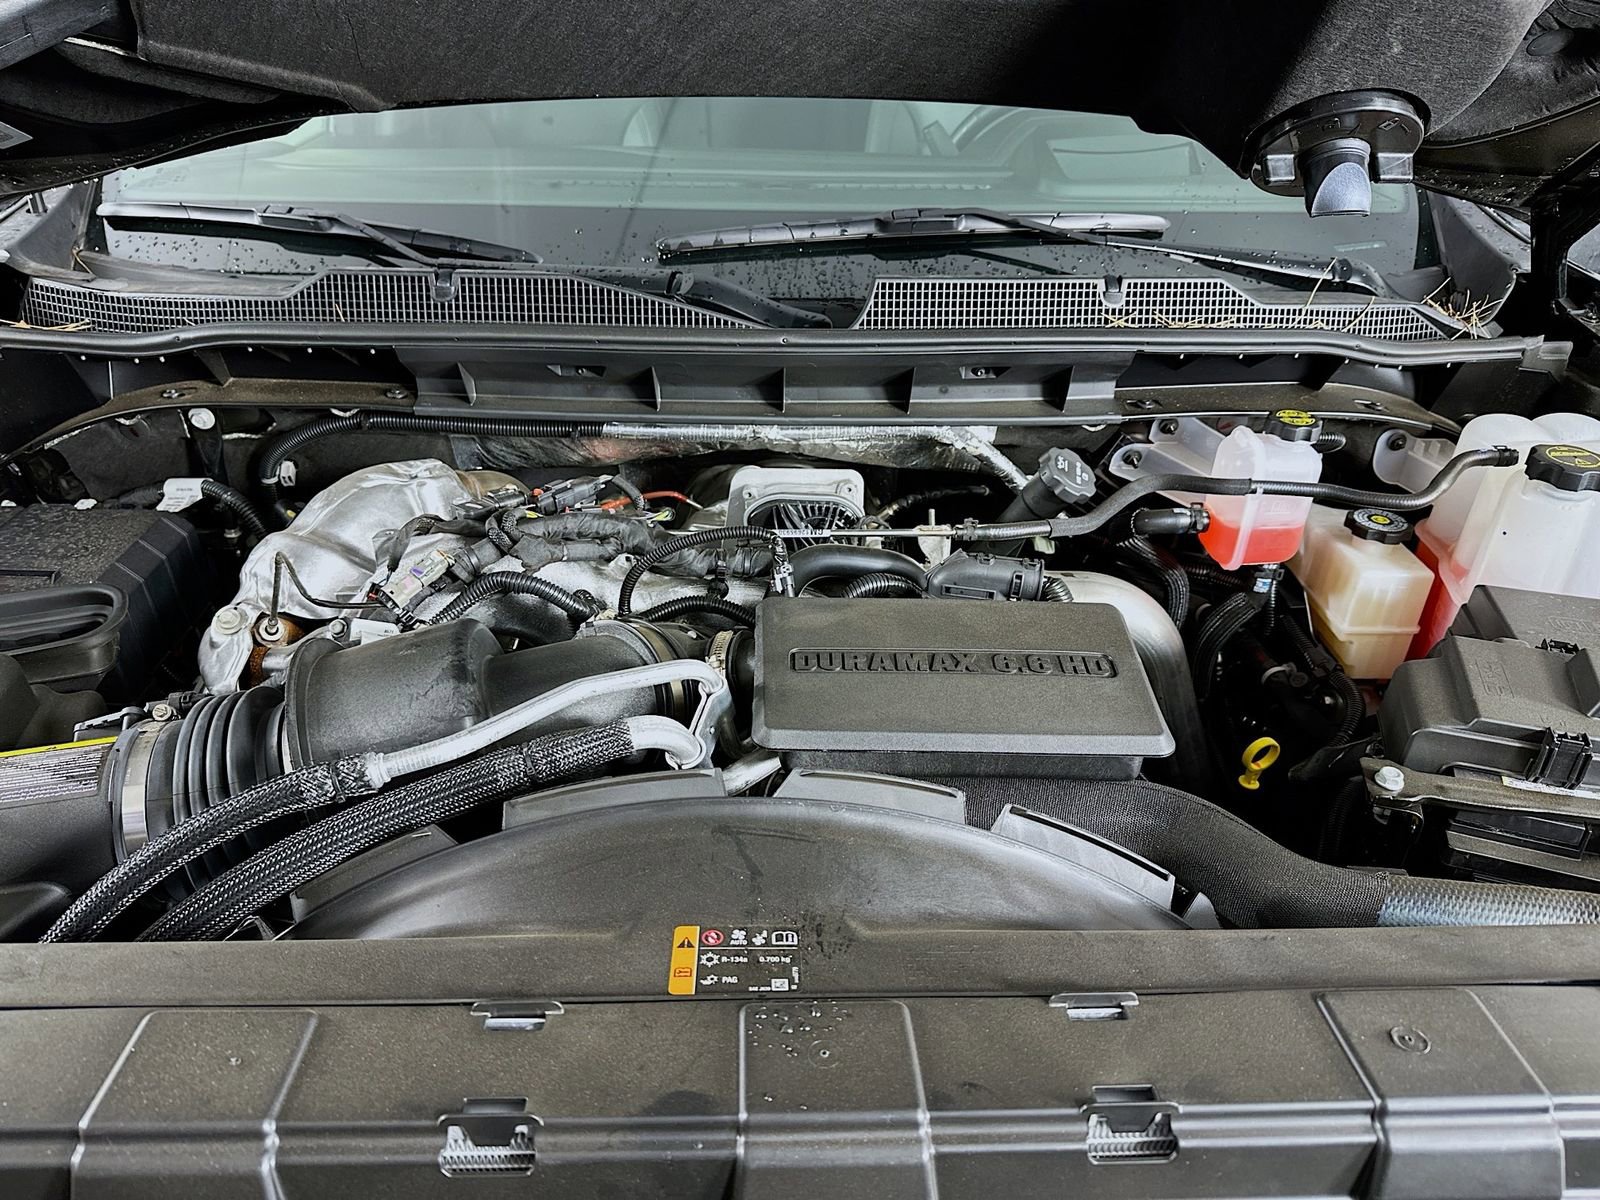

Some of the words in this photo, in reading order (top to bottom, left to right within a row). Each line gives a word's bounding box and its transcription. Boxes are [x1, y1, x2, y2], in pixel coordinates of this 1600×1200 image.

[794, 651, 978, 673] DURAMAX
[991, 654, 1055, 675] 6.6
[1057, 655, 1113, 675] HD
[722, 976, 738, 984] PAG
